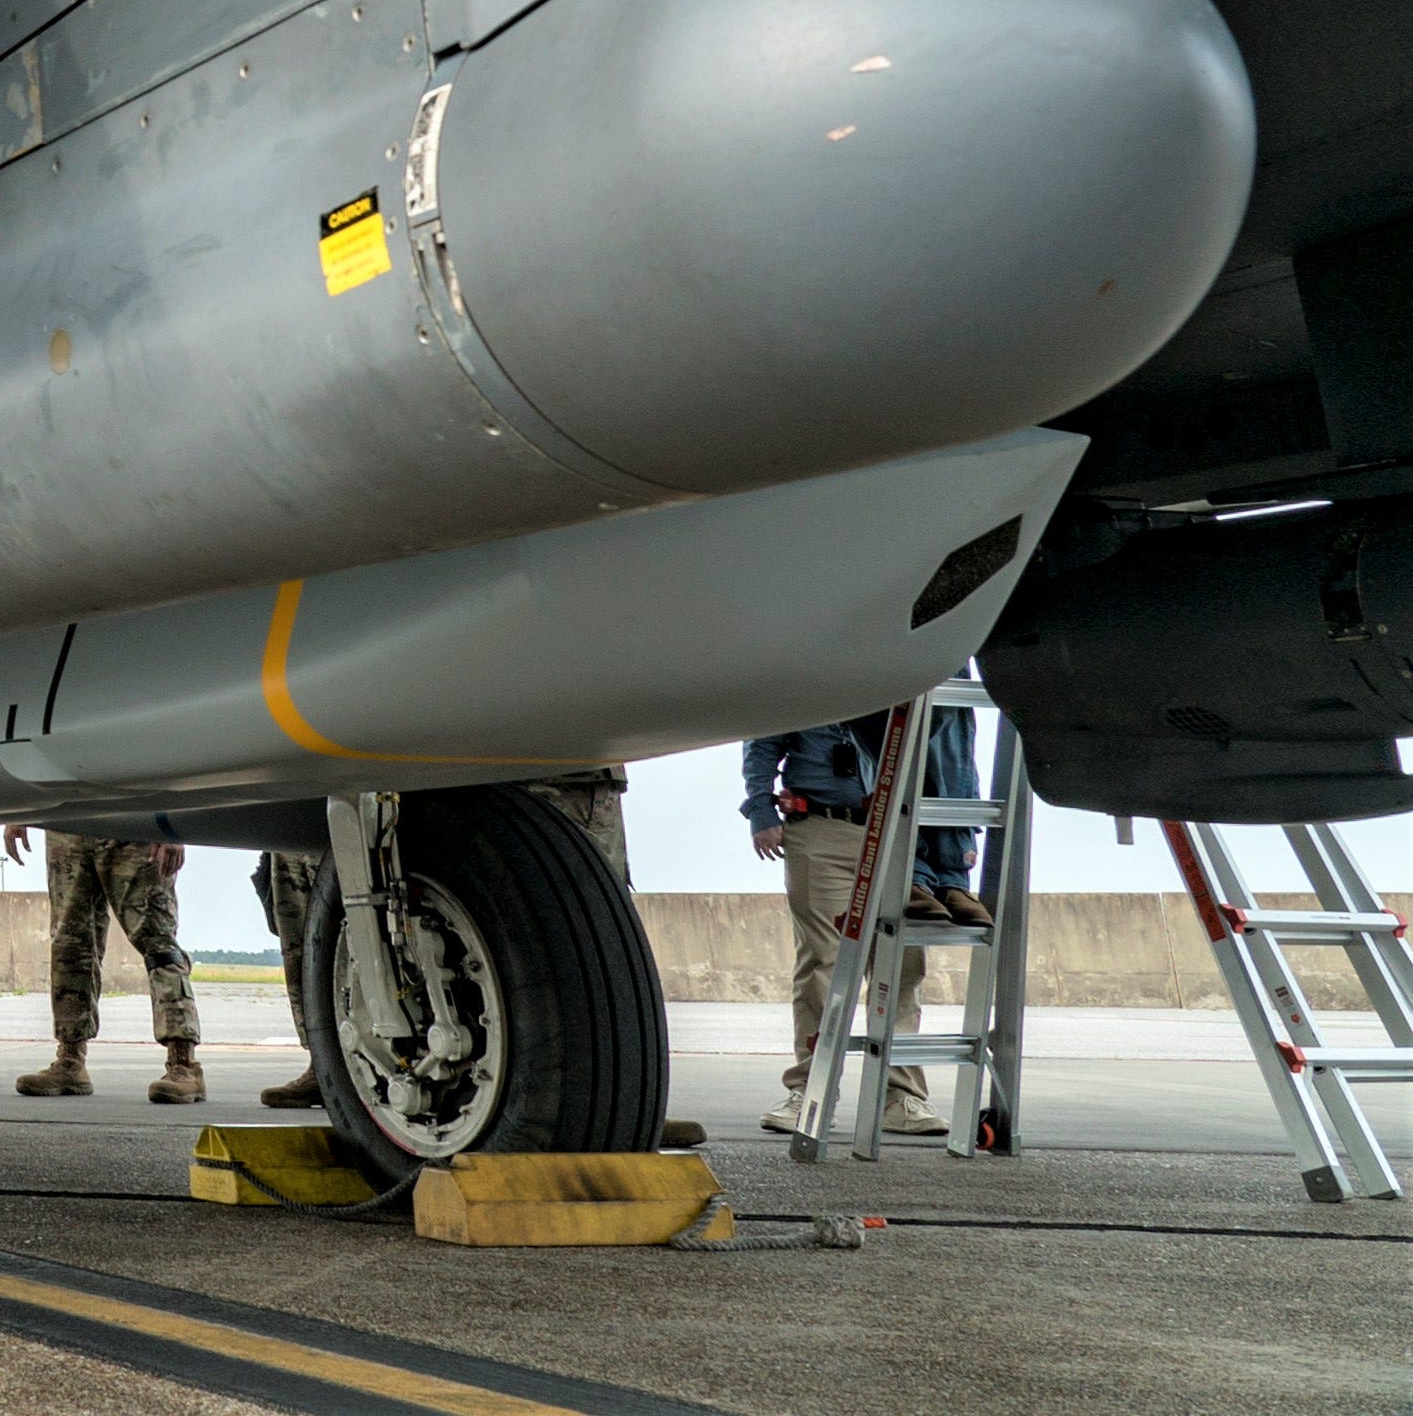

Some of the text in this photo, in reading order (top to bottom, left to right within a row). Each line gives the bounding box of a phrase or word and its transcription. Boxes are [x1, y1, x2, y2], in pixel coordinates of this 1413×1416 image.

[328, 195, 372, 230] CAUTION
[851, 726, 902, 919] Little Giant Ladder Systems
